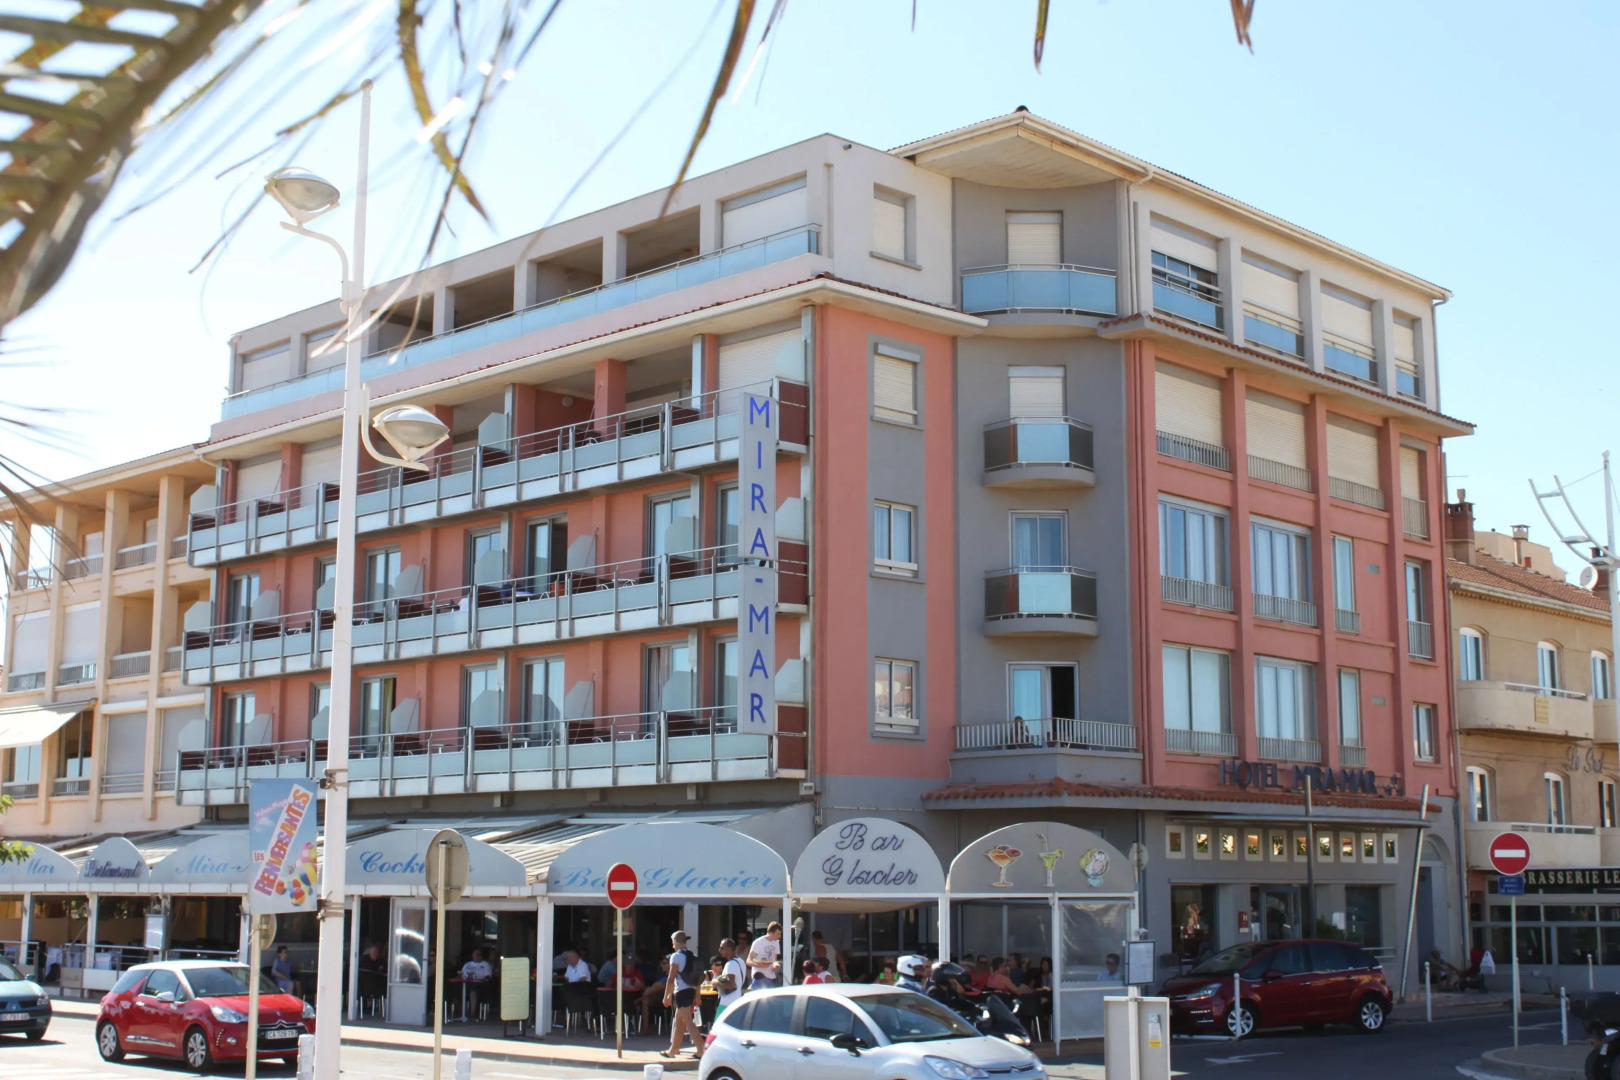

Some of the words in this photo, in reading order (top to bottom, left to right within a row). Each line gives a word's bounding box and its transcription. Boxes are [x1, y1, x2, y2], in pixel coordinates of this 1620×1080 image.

[1219, 760, 1284, 789] HOTEL
[254, 789, 310, 897] RENVERSANTES
[835, 823, 904, 851] Bar
[553, 867, 607, 888] Ba
[643, 867, 773, 889] Glacier
